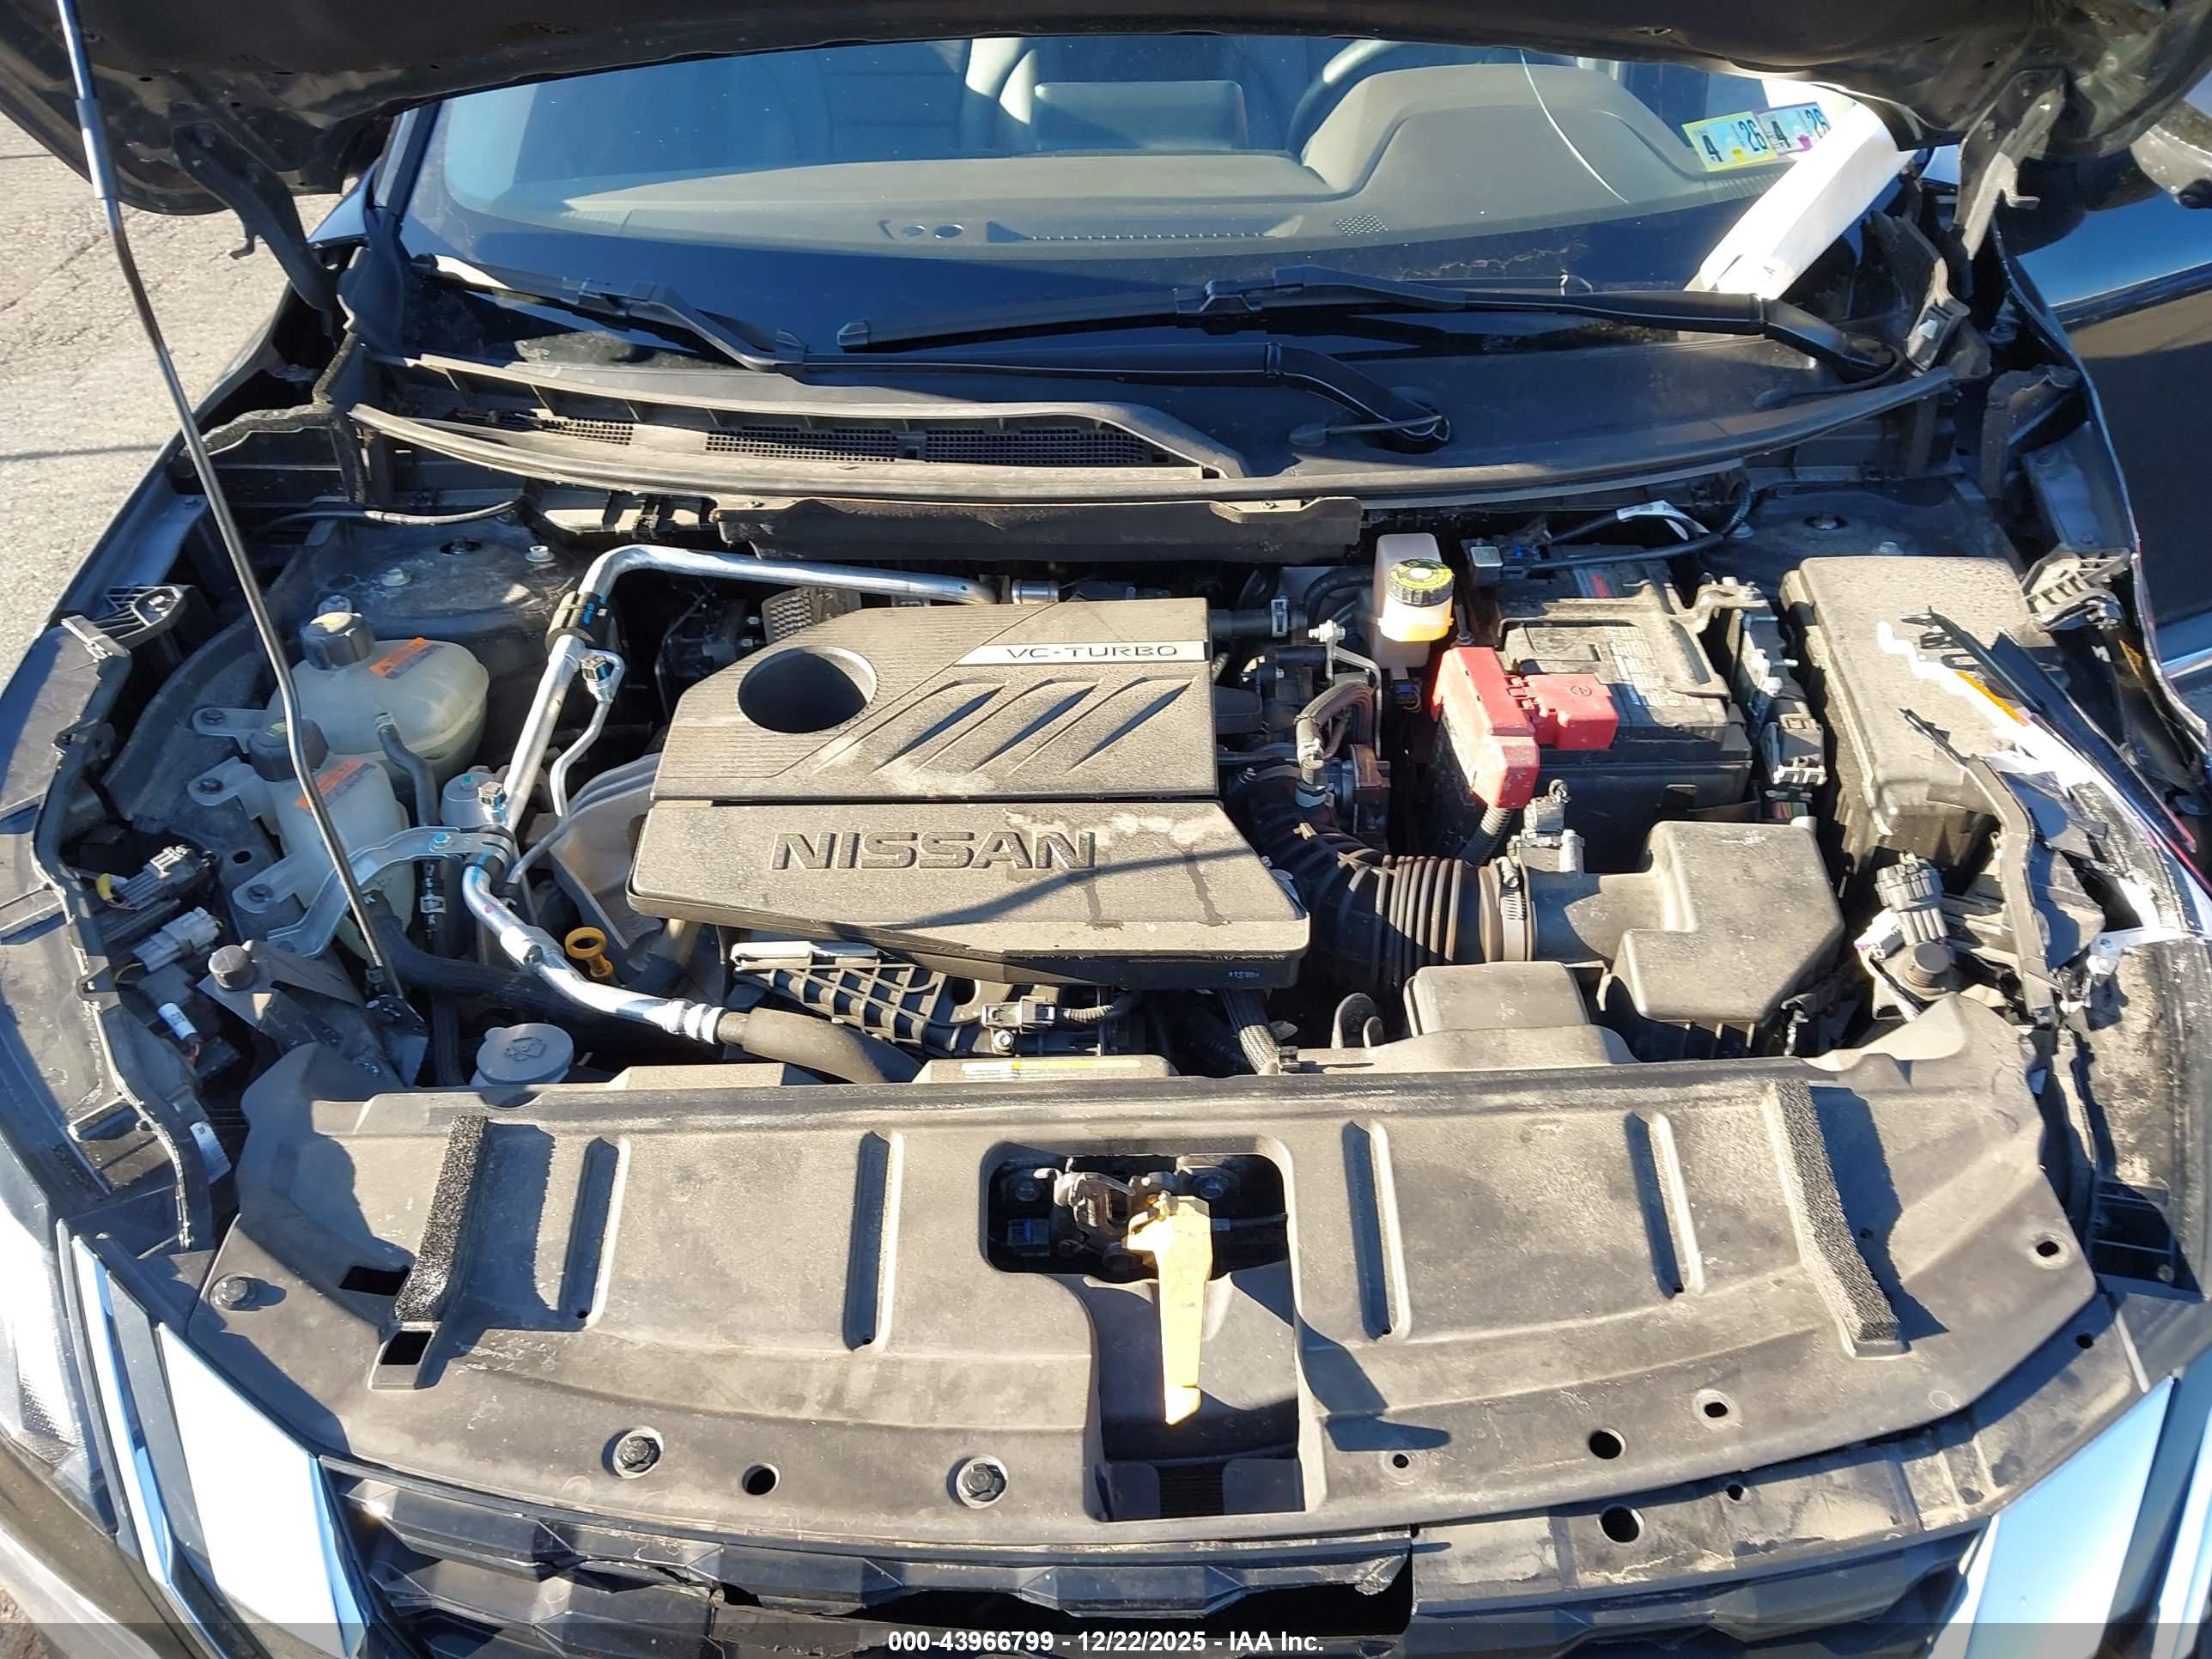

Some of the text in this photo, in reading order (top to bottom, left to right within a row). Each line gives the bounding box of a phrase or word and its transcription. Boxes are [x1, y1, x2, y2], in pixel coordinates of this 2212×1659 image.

[1702, 118, 1767, 162] 4 26
[1771, 120, 1791, 148] 4
[770, 830, 1096, 870] NISSAN
